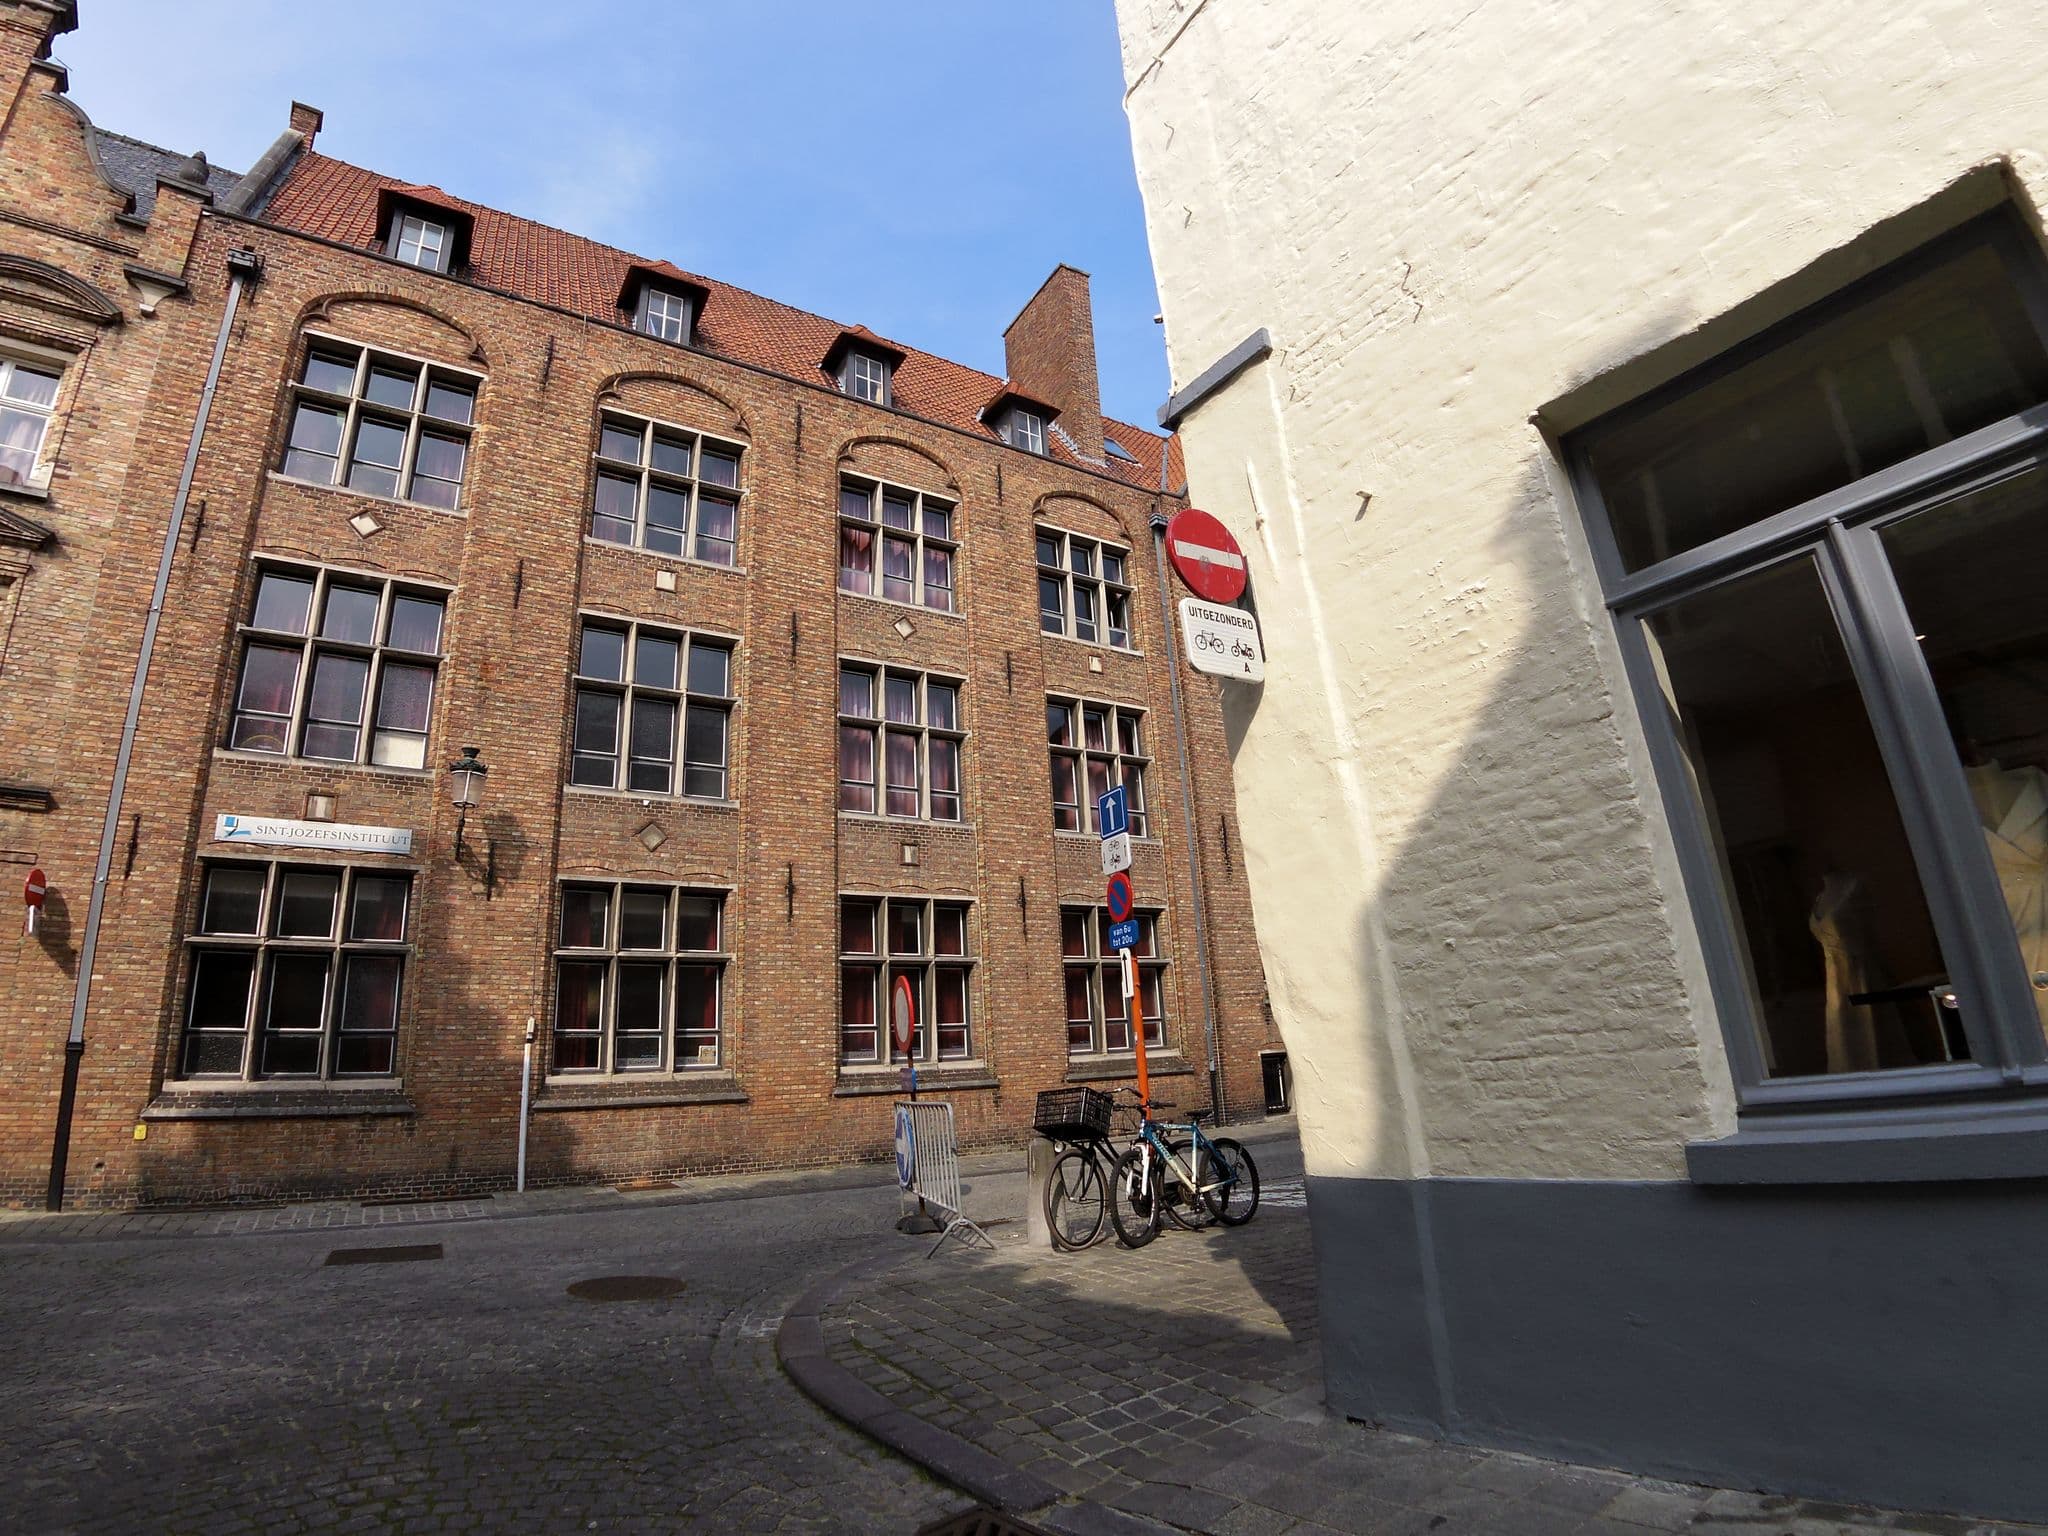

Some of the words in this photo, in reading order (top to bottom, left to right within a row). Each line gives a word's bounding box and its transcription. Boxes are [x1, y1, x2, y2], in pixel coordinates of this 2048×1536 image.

[1188, 606, 1253, 630] UITGEZONDERD
[1244, 662, 1251, 673] A
[1113, 928, 1123, 936] van
[1123, 924, 1132, 933] 6u
[1112, 938, 1121, 946] tot
[1121, 935, 1133, 944] 20u
